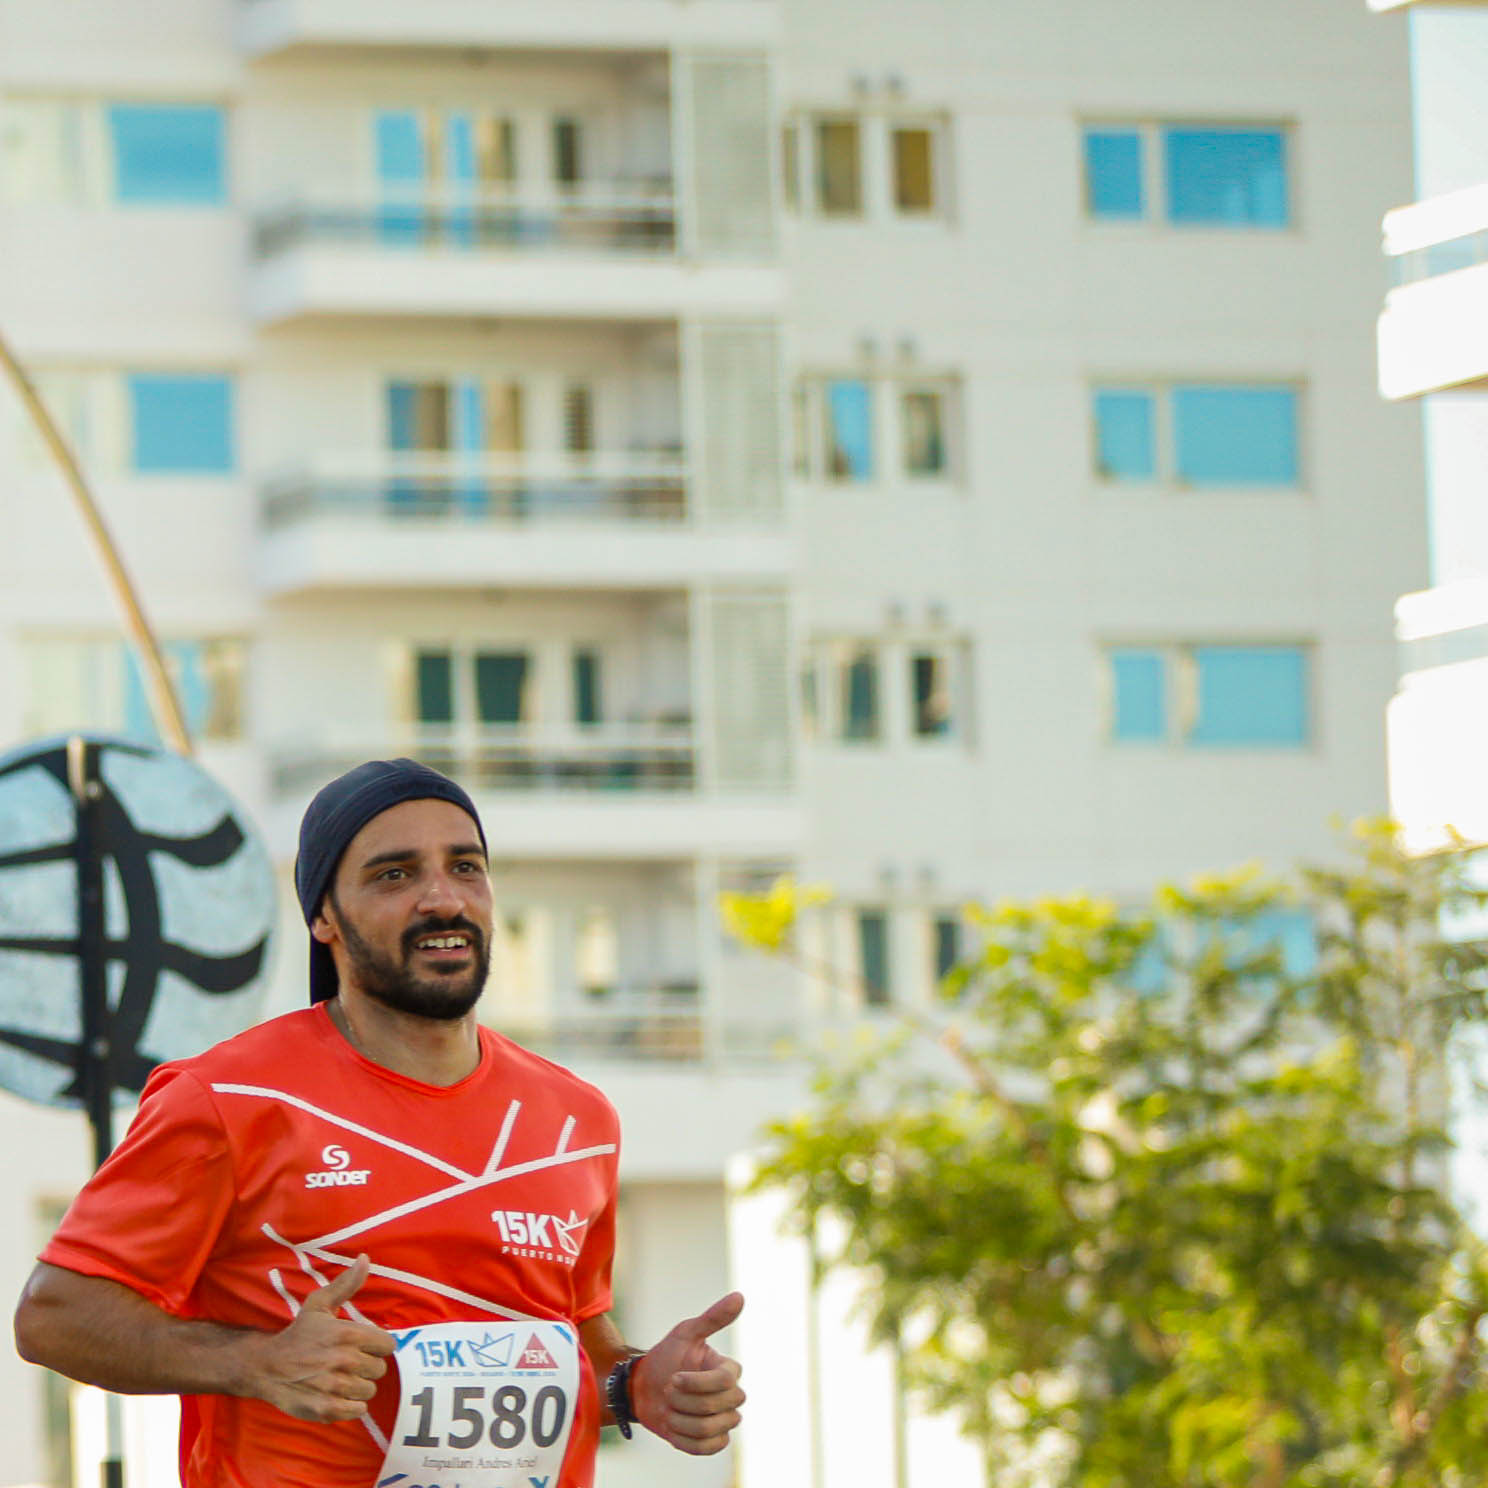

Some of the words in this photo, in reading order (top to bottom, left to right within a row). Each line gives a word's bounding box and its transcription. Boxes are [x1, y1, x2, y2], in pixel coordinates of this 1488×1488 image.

[491, 1210, 552, 1248] 15K
[415, 1340, 466, 1368] 15K
[525, 1350, 549, 1364] 15K
[403, 1385, 567, 1449] 1580
